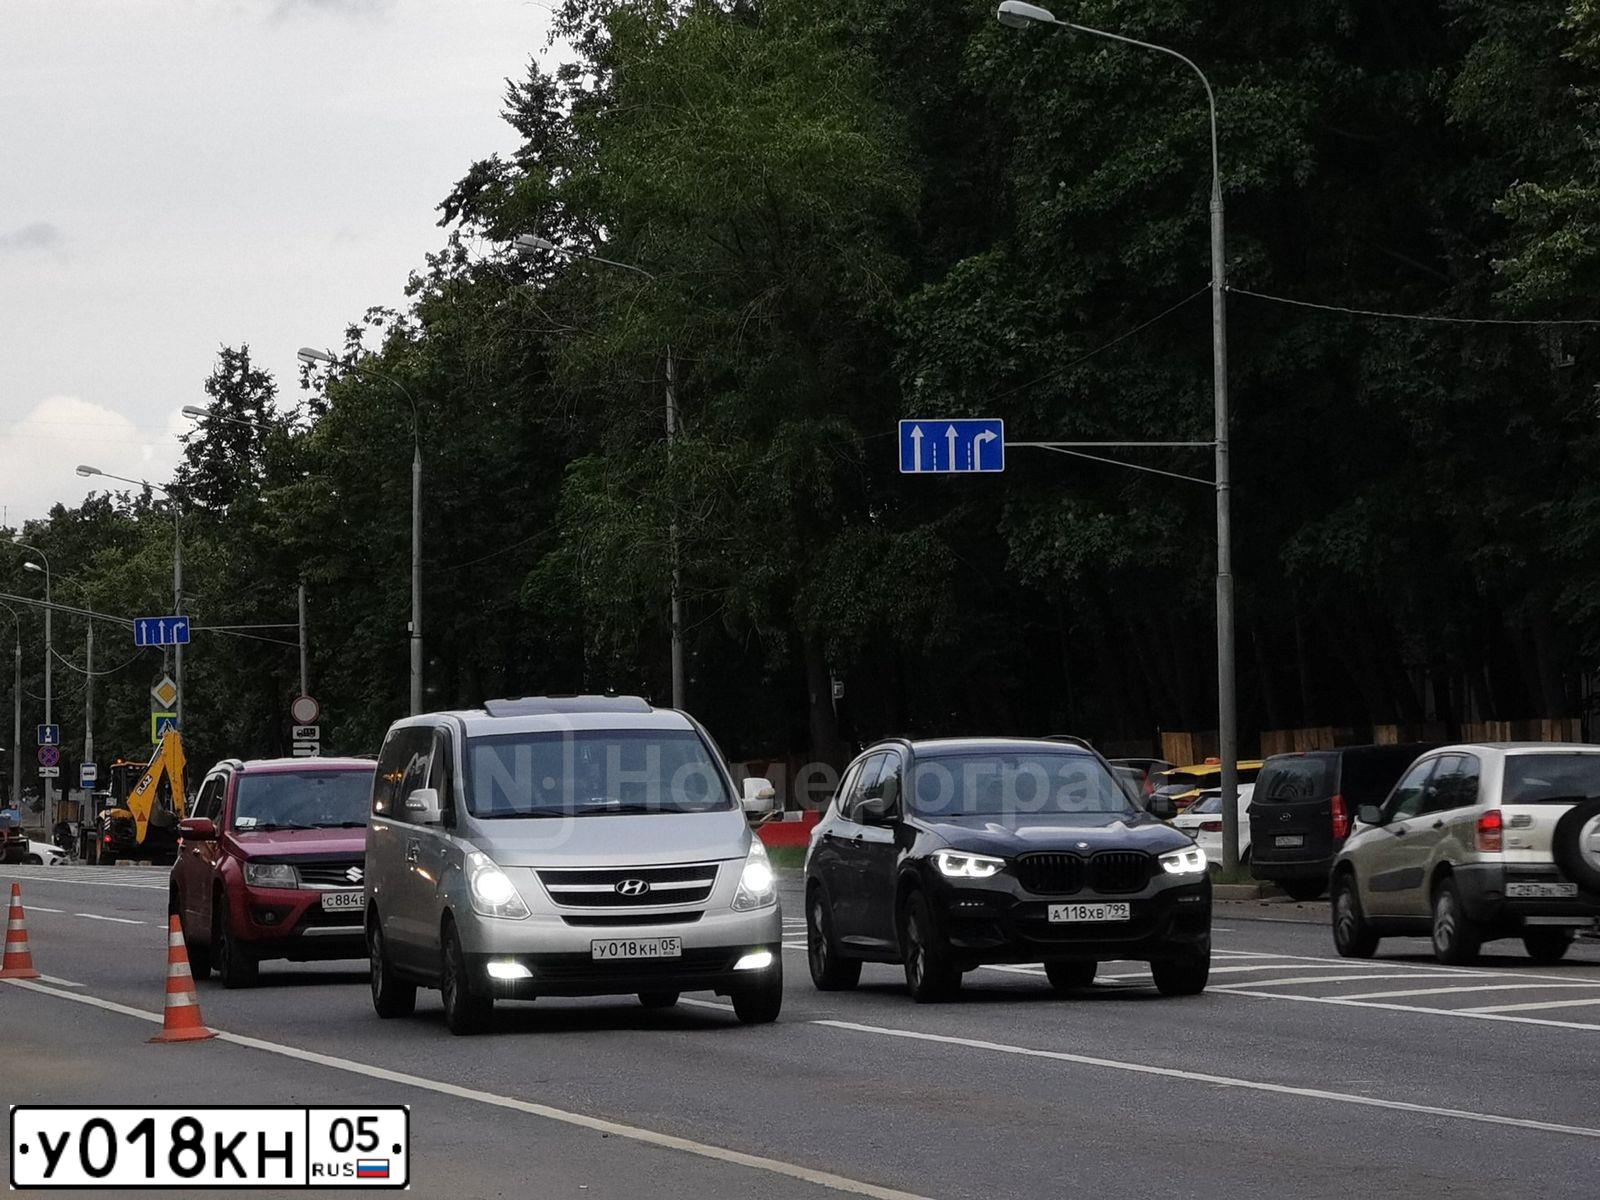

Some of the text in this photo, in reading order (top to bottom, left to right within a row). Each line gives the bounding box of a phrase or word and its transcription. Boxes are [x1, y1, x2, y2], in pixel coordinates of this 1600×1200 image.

[1053, 904, 1127, 920] А118ХВ 799
[599, 939, 676, 957] У018КН 05
